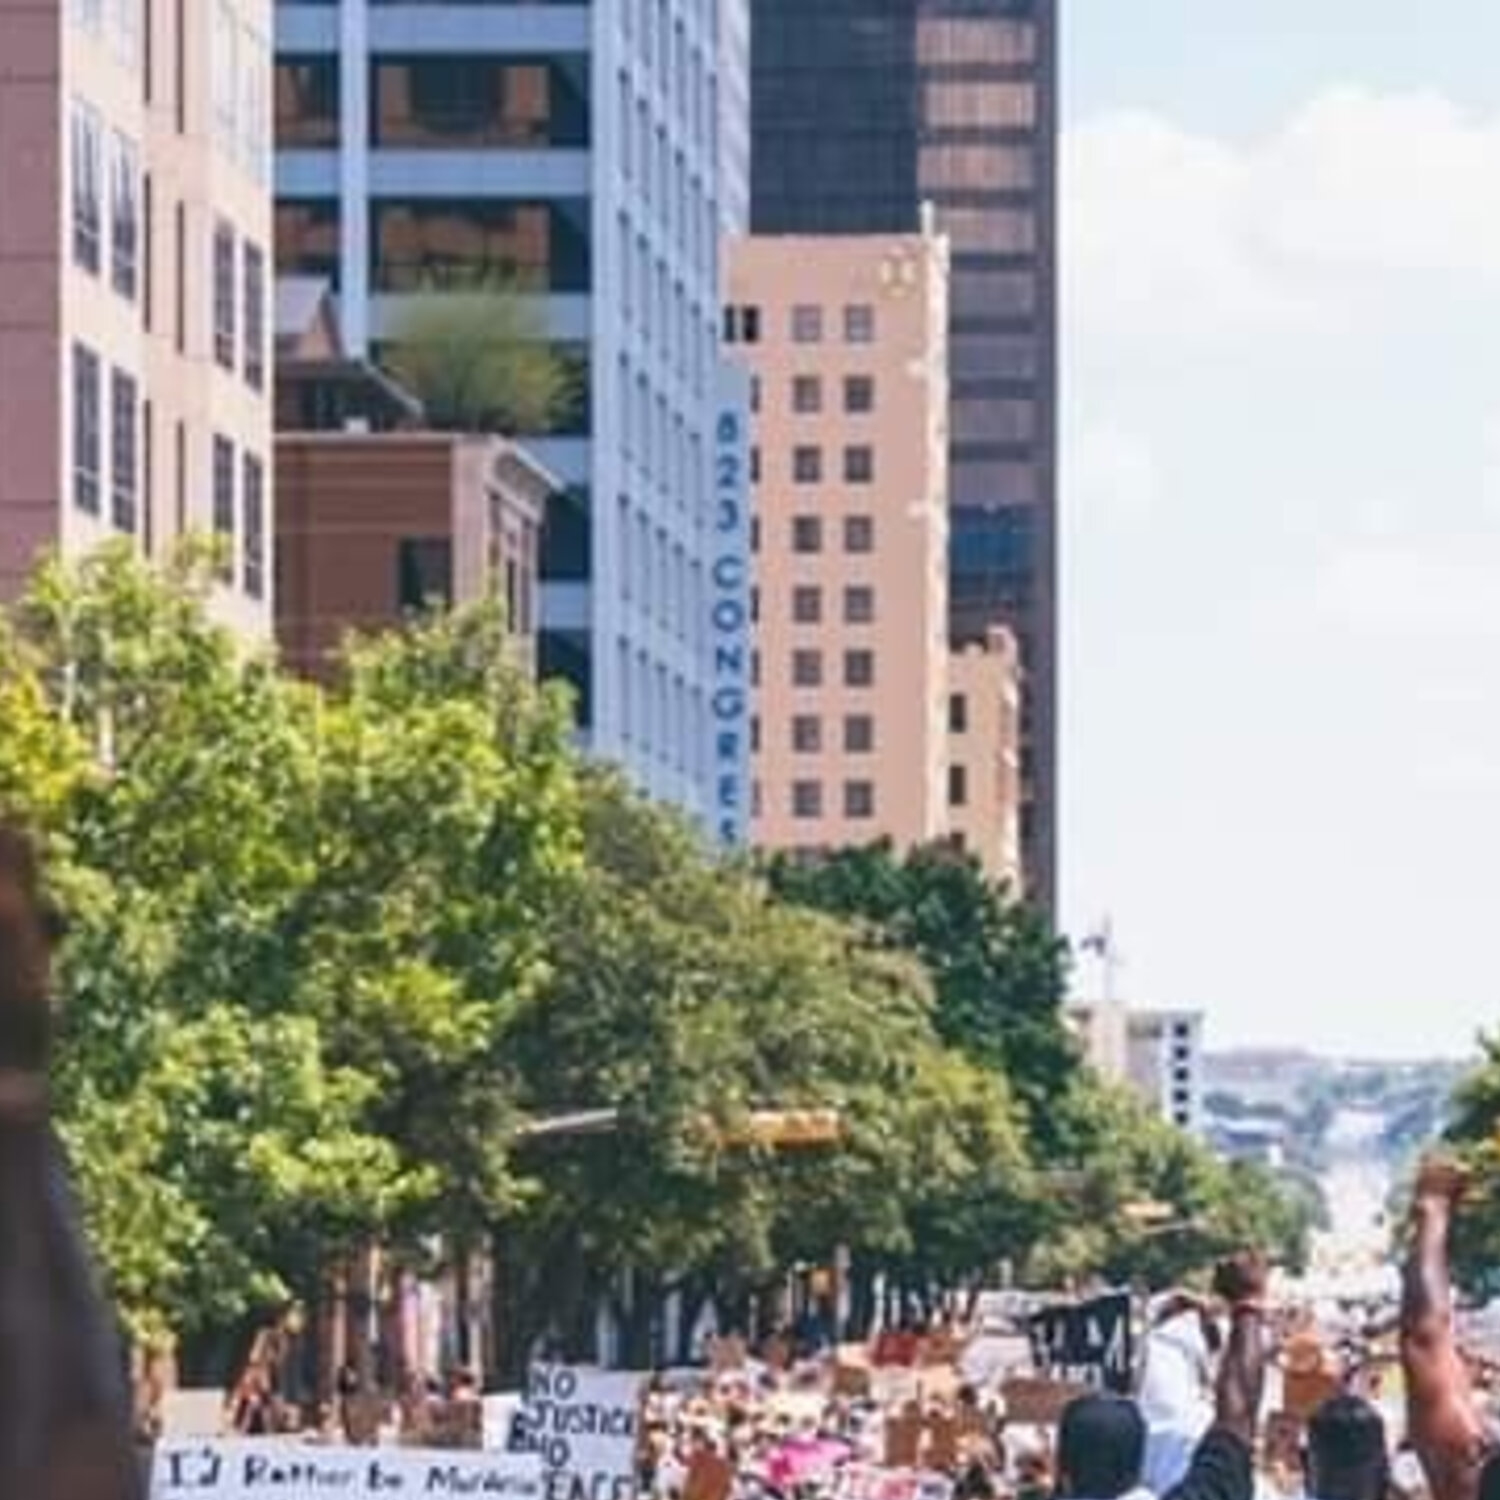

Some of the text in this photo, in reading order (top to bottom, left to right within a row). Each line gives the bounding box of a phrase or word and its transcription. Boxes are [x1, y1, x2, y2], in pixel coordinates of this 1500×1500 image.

[711, 554, 743, 844] CONGRES
[530, 1368, 576, 1400] NO
[244, 1454, 353, 1487] Rather
